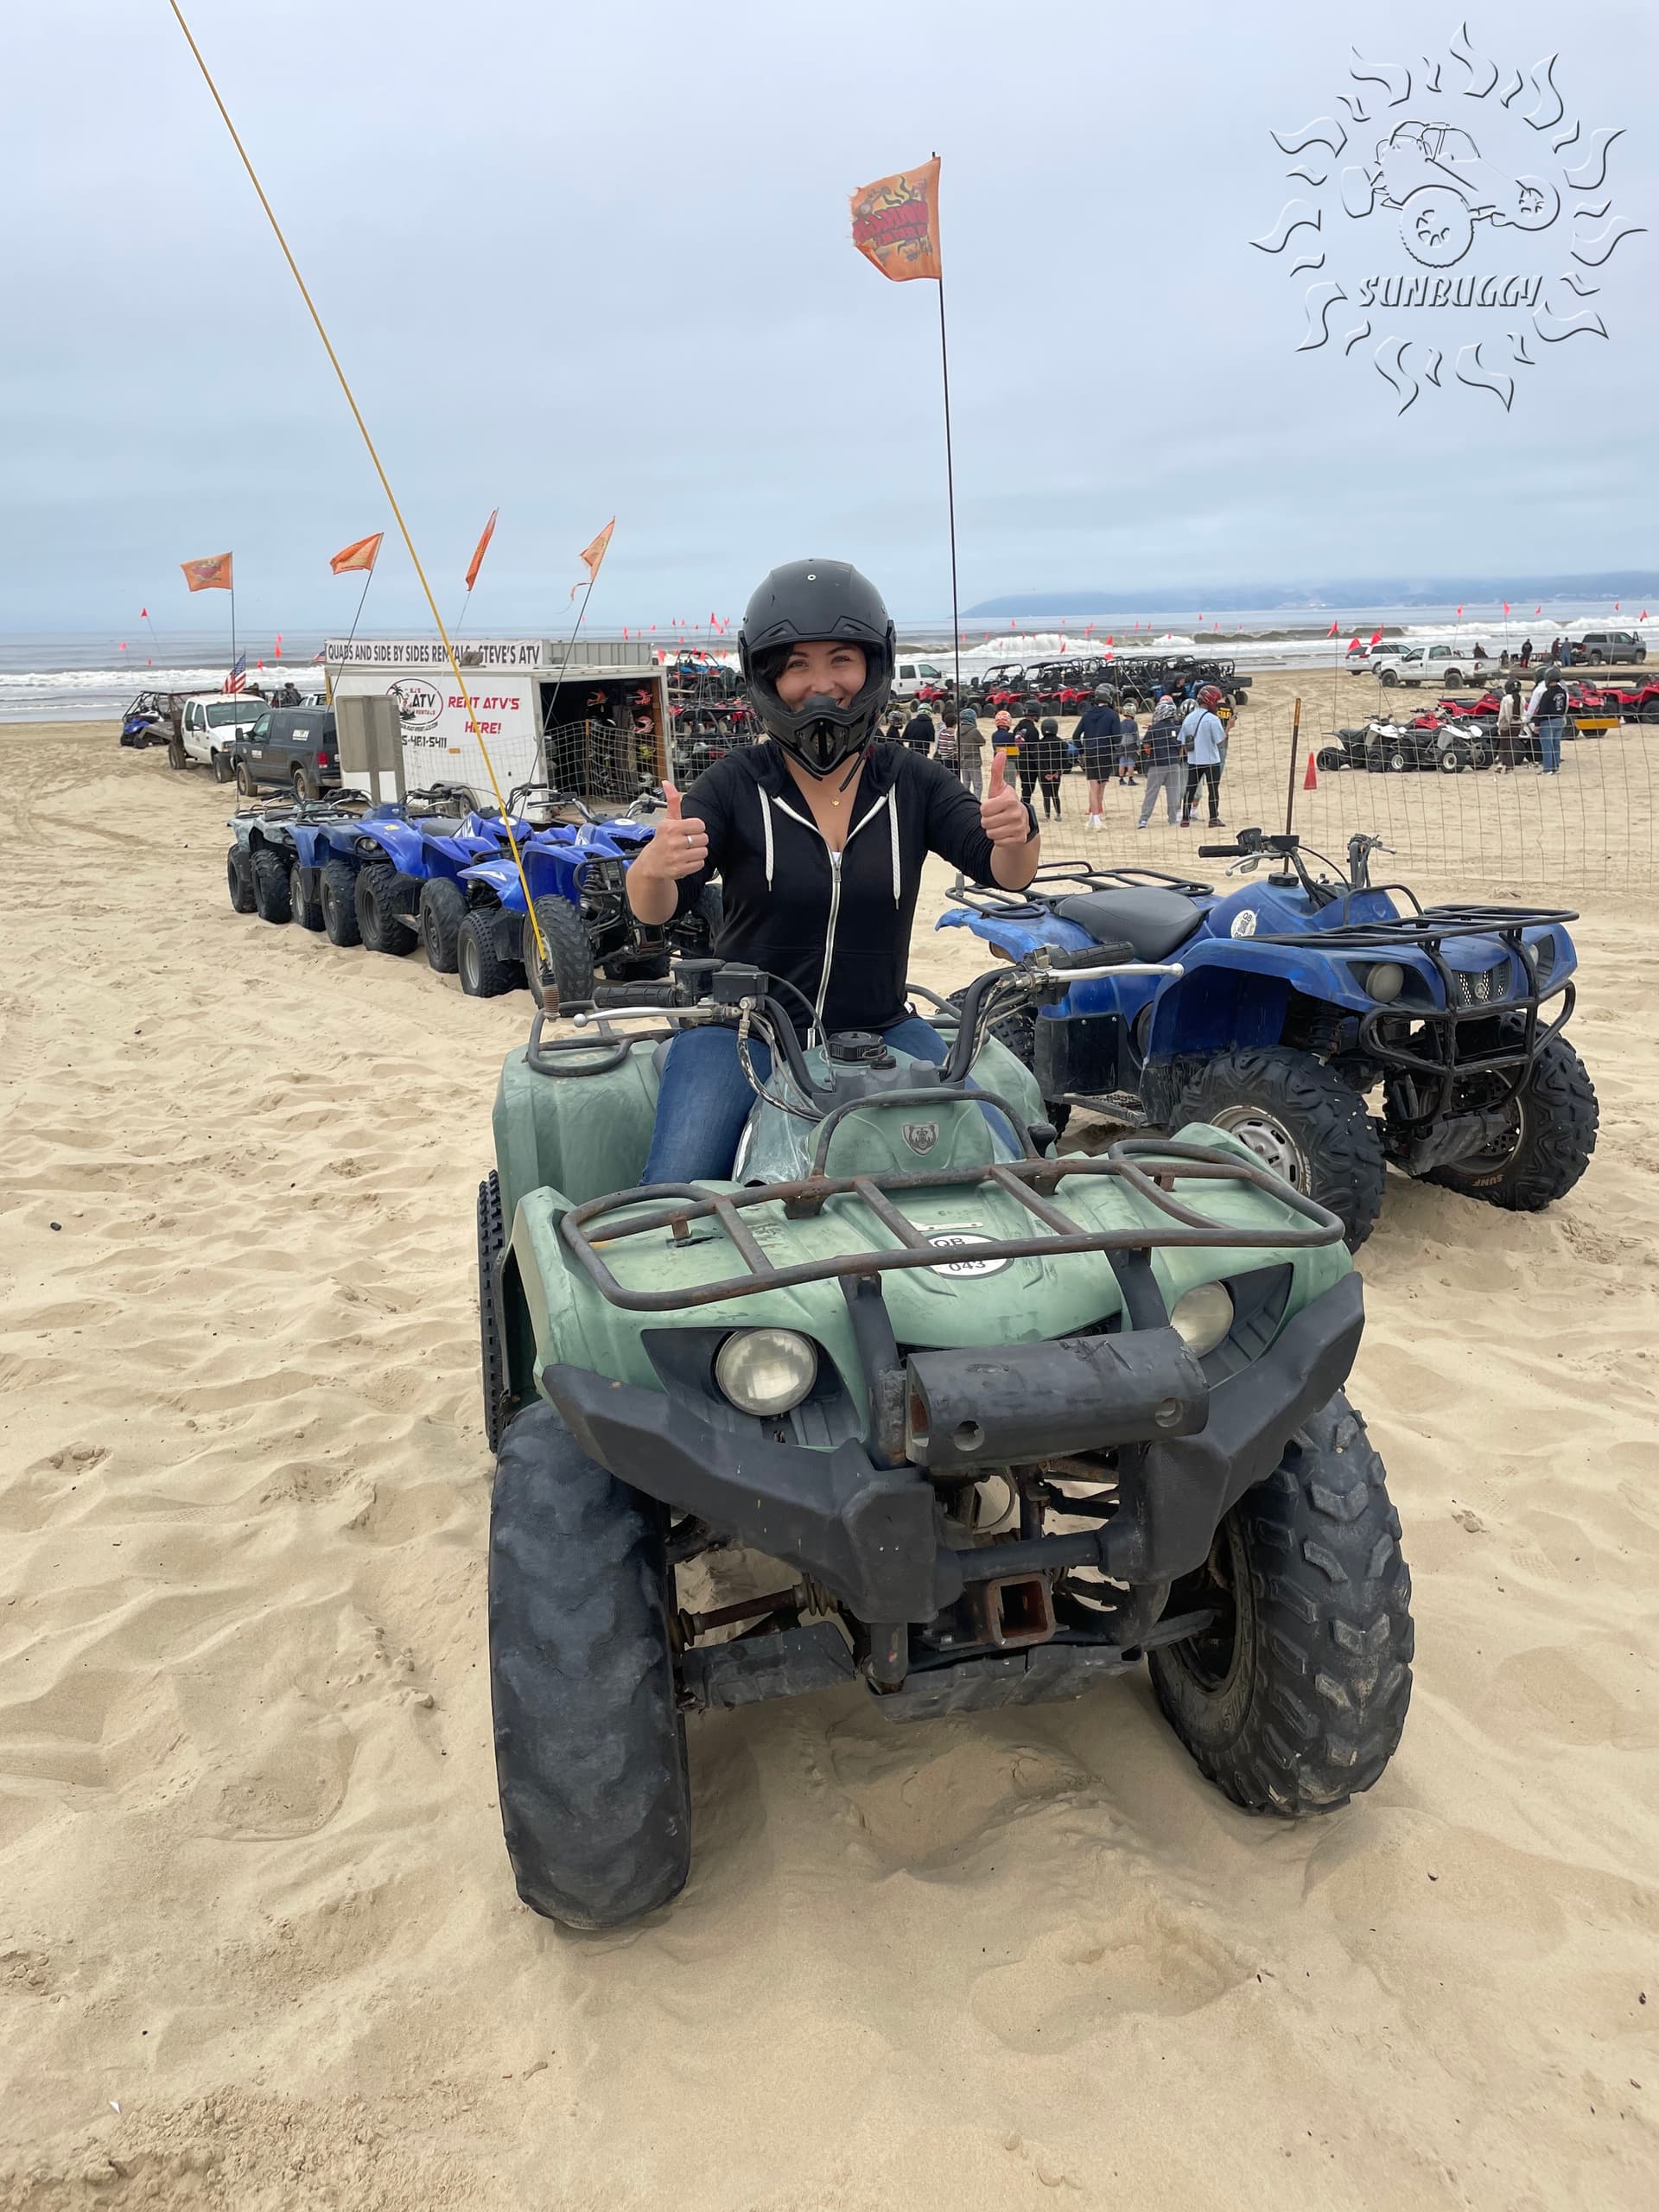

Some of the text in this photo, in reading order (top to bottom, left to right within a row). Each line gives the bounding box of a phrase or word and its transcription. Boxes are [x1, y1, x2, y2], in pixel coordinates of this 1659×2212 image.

[328, 645, 353, 660] QUADS
[355, 645, 372, 660] AND
[374, 645, 391, 661] SIDE
[394, 645, 404, 661] BY
[406, 645, 429, 662] SIDES
[519, 646, 539, 664] ATV
[412, 694, 435, 708] ATV
[448, 696, 520, 710] RENT ATV'S
[465, 721, 501, 734] HERE!
[934, 1237, 965, 1248] QB
[949, 1260, 986, 1271] 043
